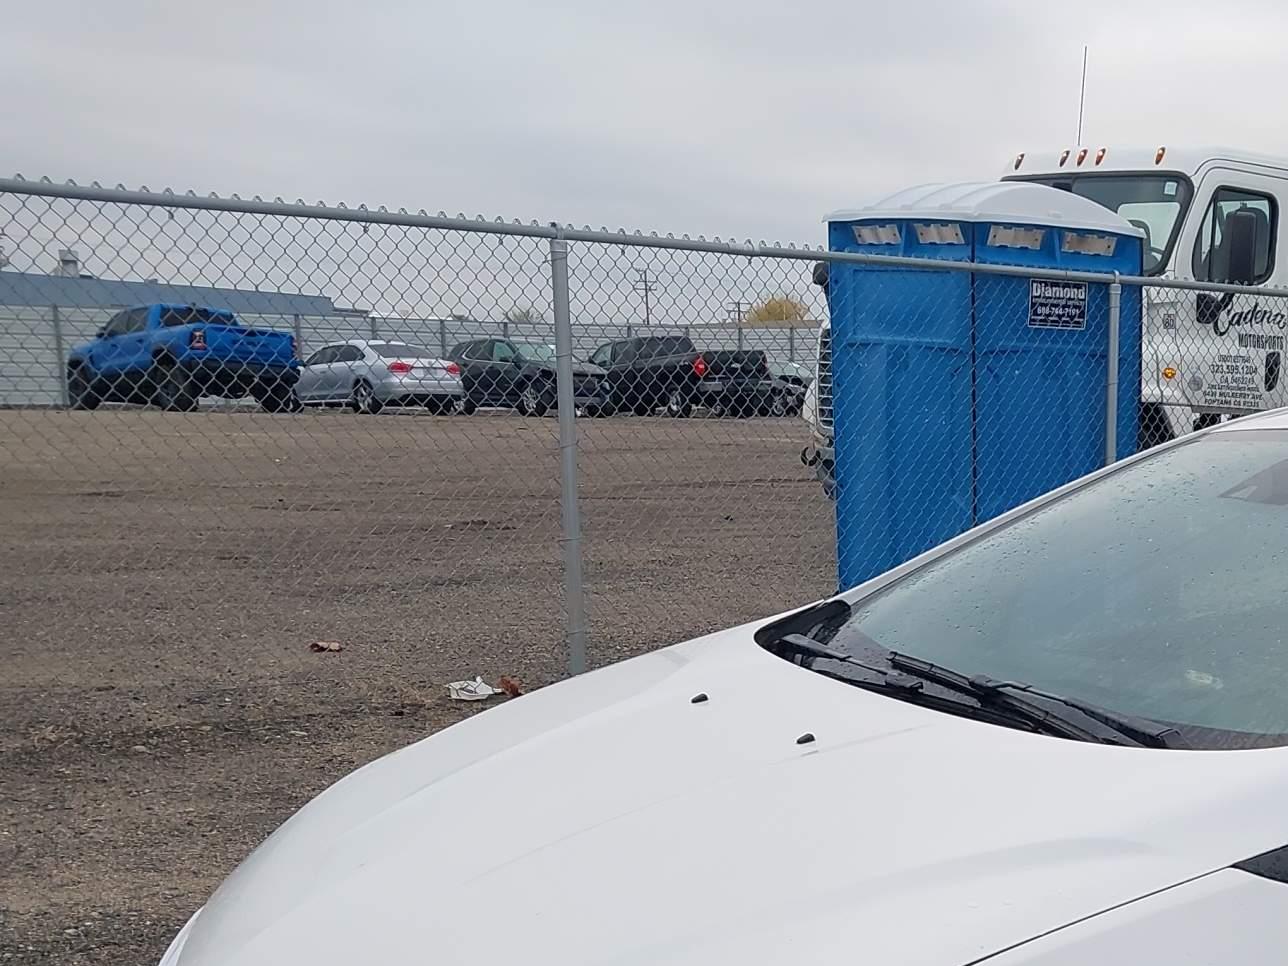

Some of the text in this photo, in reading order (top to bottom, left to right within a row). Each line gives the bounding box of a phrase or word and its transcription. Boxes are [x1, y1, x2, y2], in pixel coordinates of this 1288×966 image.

[1032, 283, 1086, 299] Diamond
[1213, 301, 1287, 336] Cadena
[1239, 333, 1284, 351] MOTORSPORTS
